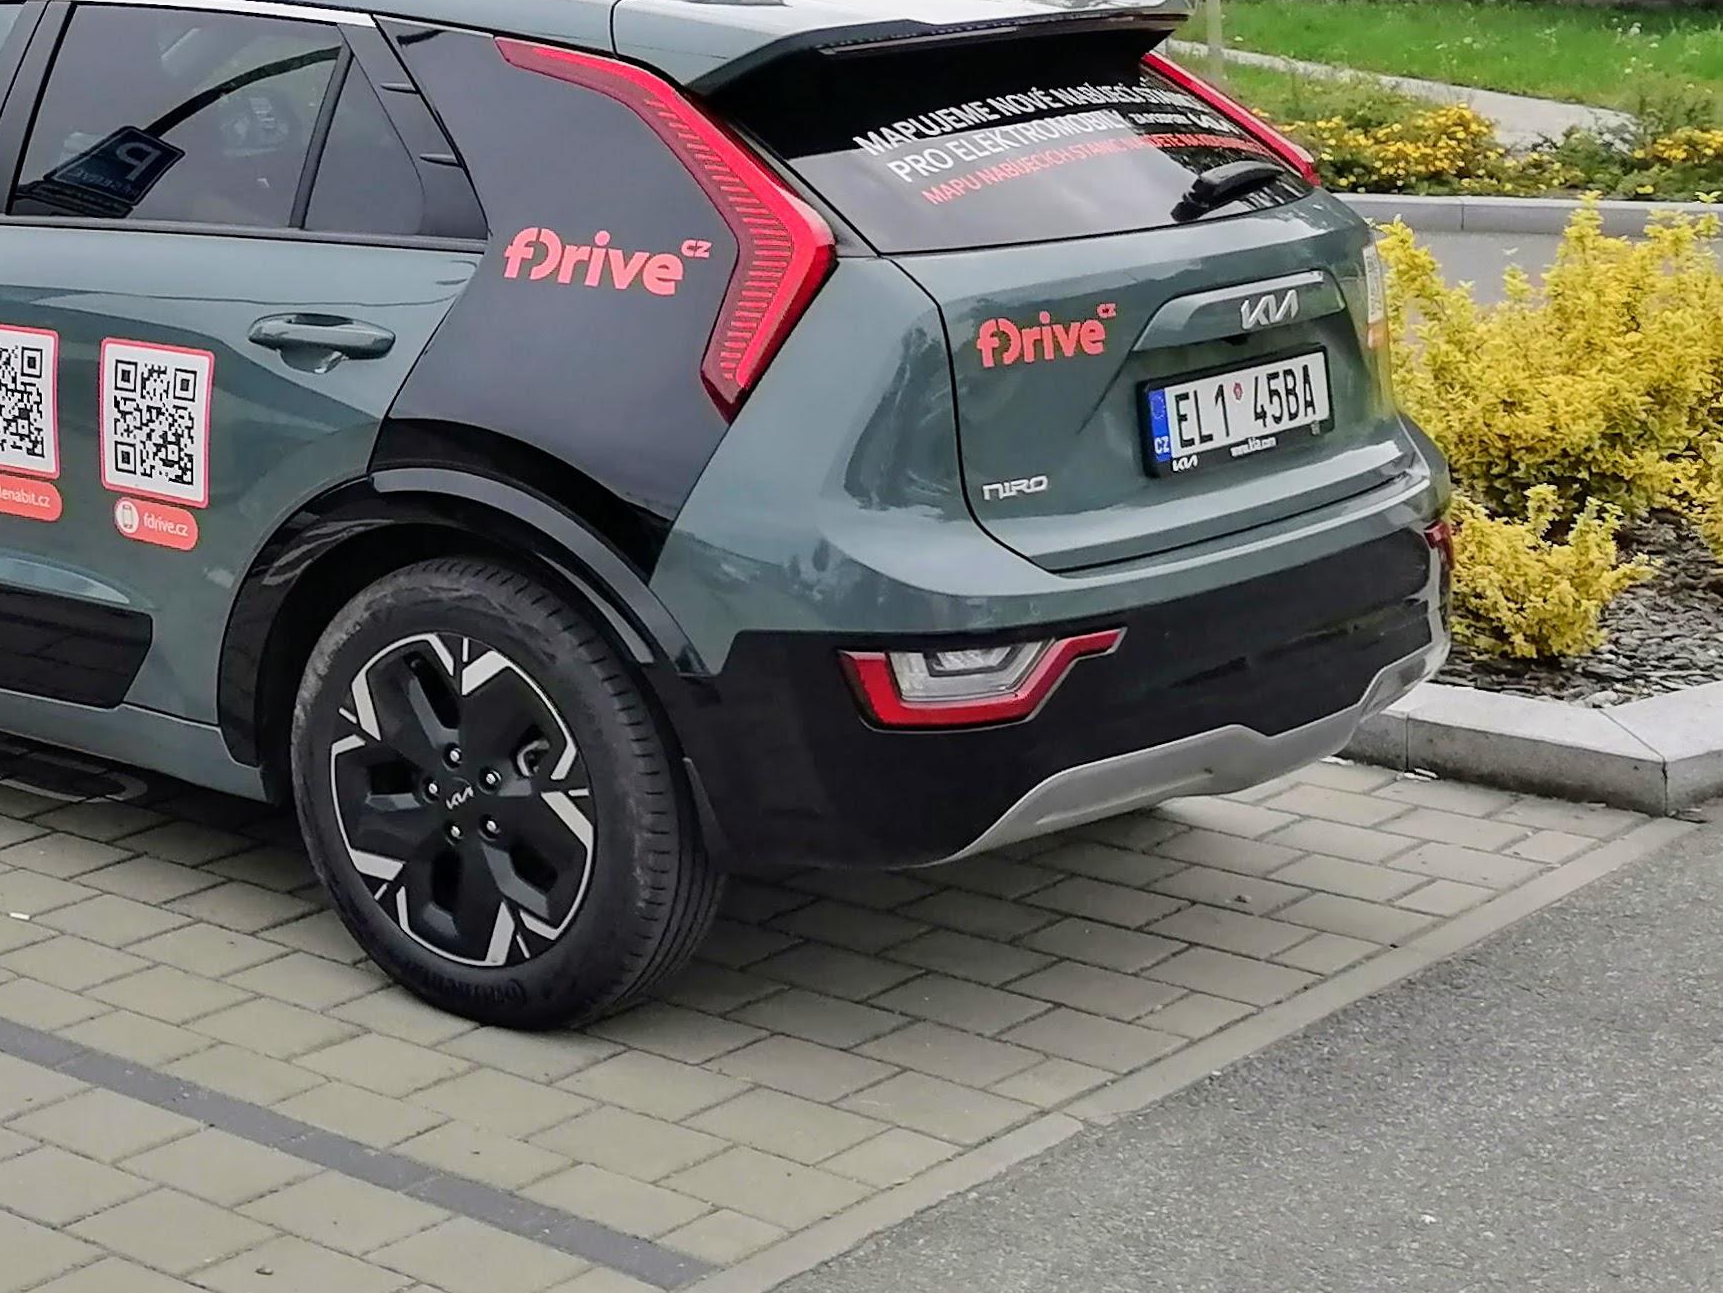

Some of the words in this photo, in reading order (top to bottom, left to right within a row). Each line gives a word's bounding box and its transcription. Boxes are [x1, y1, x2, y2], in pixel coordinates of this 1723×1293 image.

[852, 101, 1000, 156] MAPUJEME
[986, 85, 1066, 118] NOVÉ
[887, 149, 955, 183] PRO
[944, 109, 1128, 162] ELEKTROMOBILY
[921, 173, 982, 205] MAPU
[1253, 364, 1317, 429] 45BA
[1154, 436, 1171, 454] CZ
[143, 511, 189, 537] fdrive.cz
